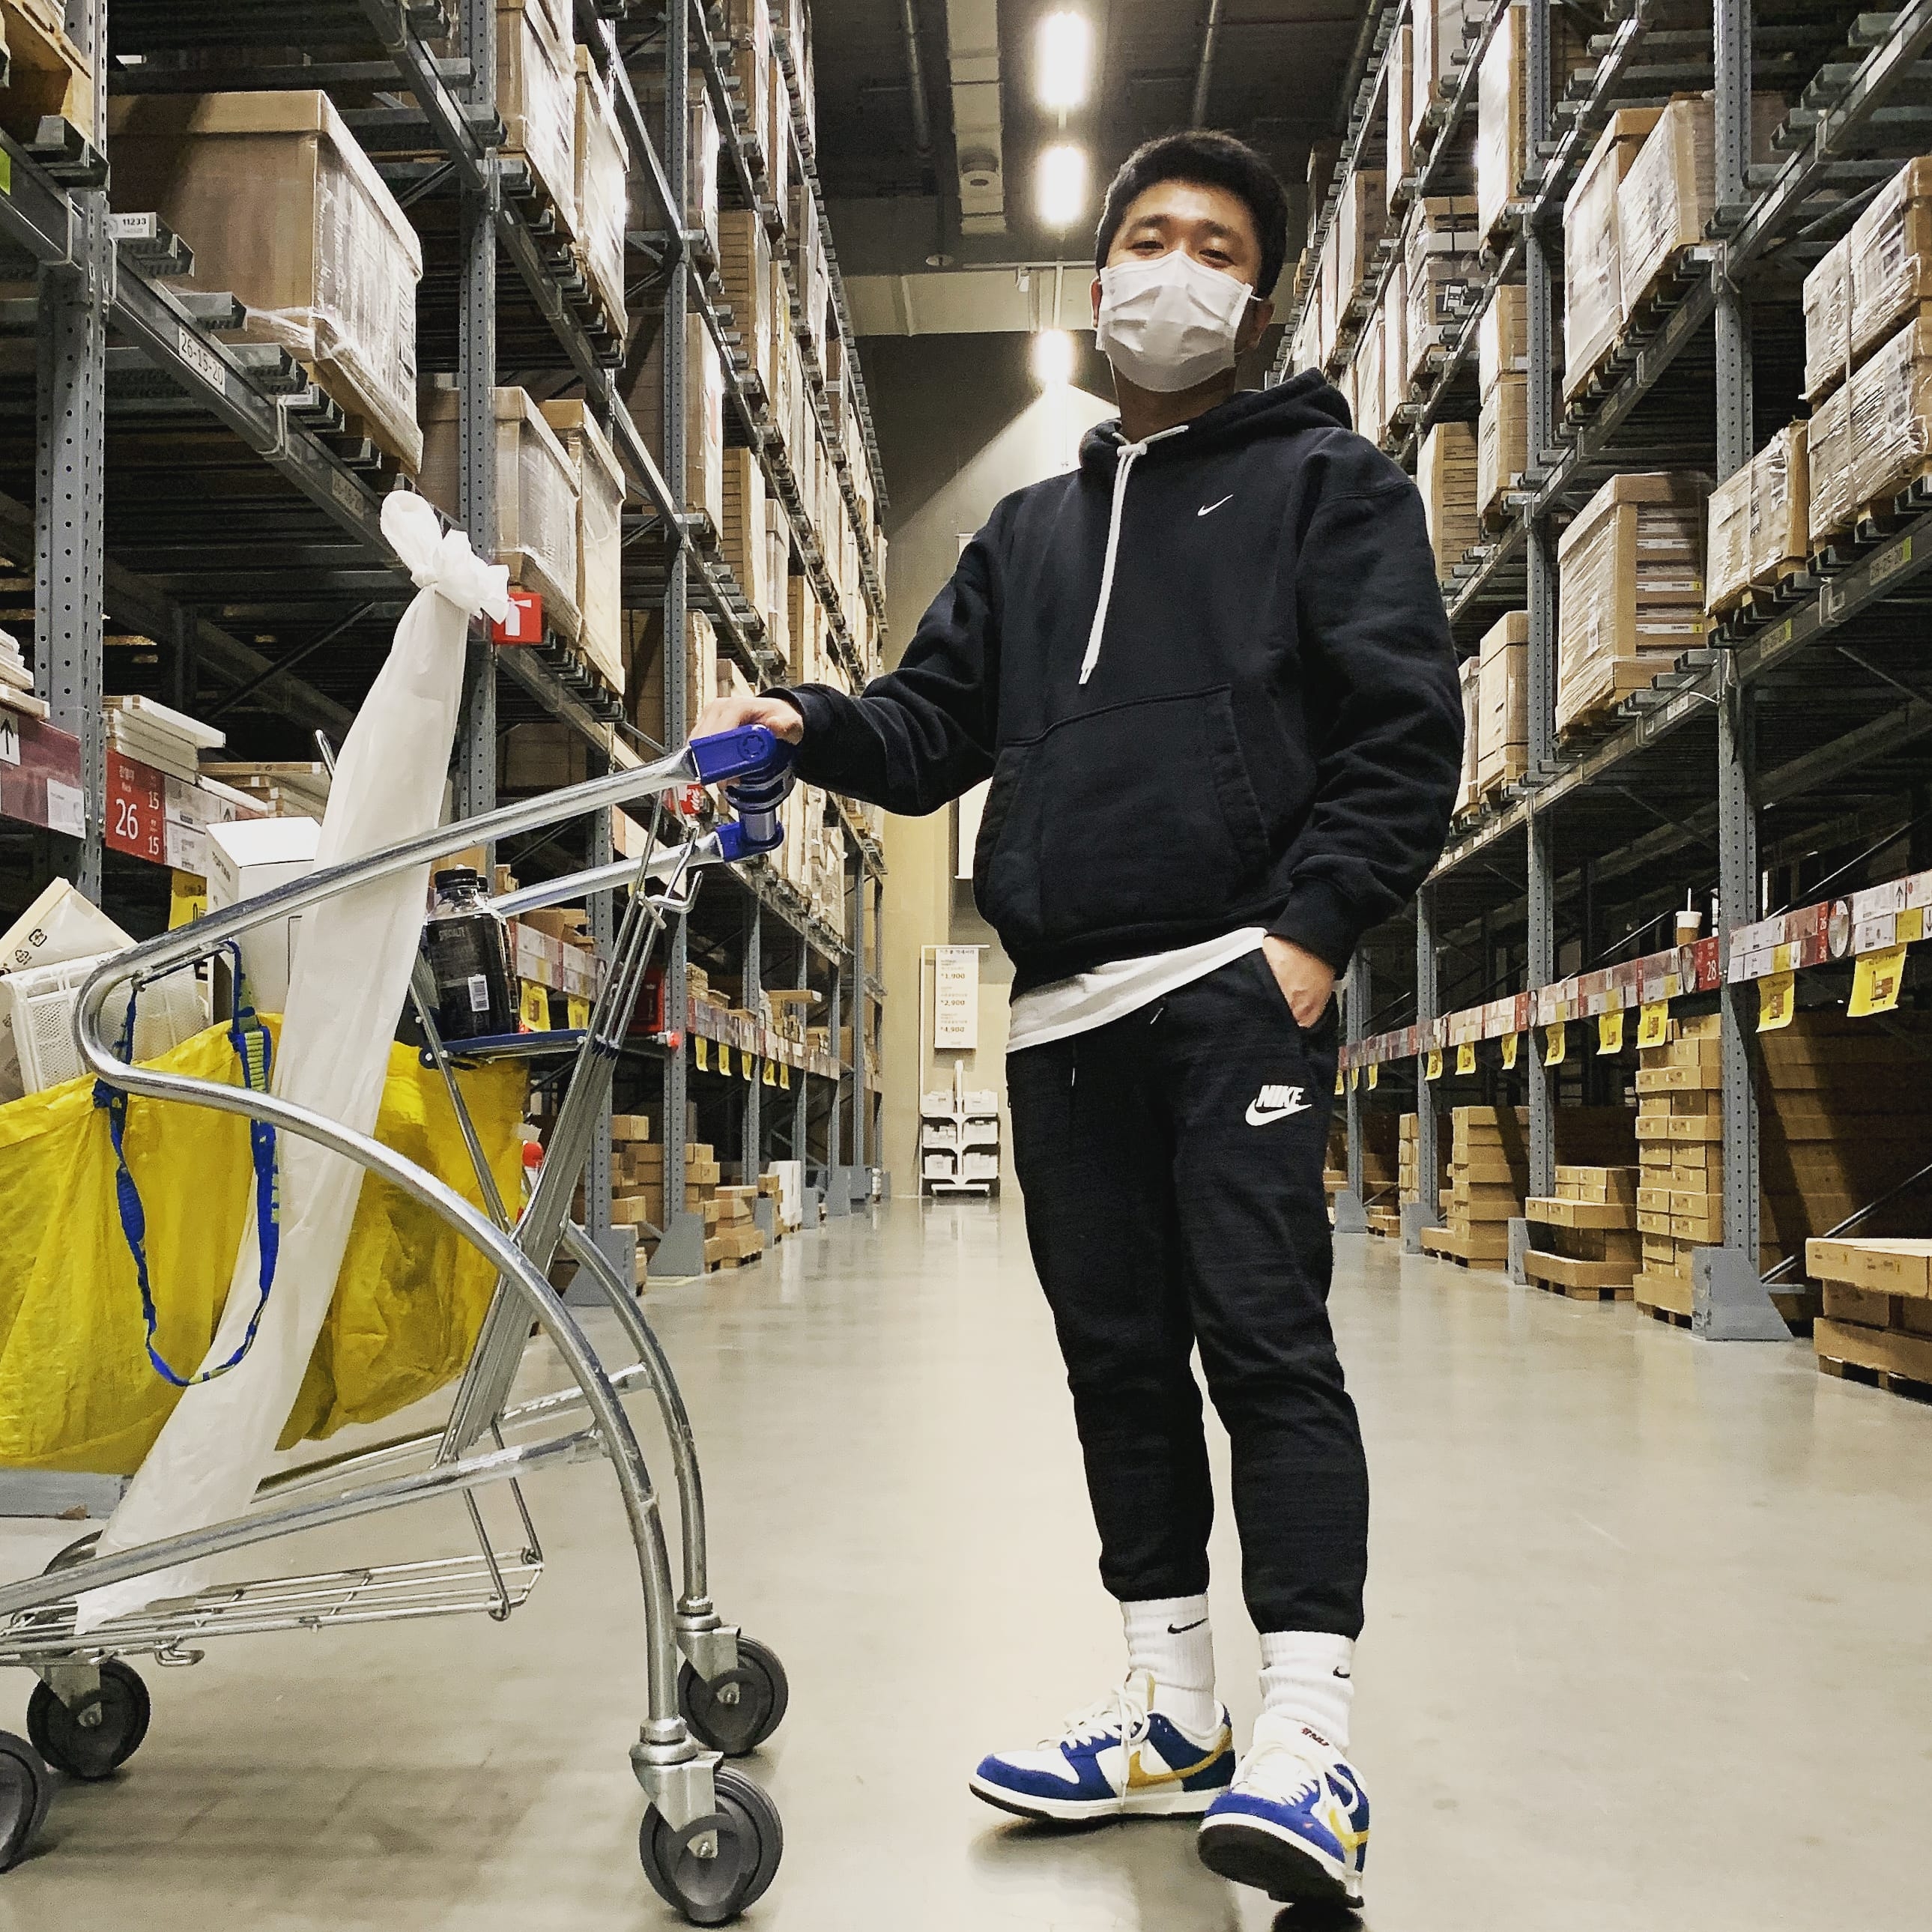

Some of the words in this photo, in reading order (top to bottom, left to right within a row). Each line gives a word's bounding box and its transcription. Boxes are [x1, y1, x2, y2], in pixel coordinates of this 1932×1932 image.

[123, 217, 147, 225] 11233
[181, 333, 223, 386] 26-15-20
[148, 790, 160, 810] 15
[115, 798, 139, 840] 26
[148, 836, 160, 856] 15
[1707, 960, 1717, 981] 28
[1256, 1085, 1304, 1108] NIKE
